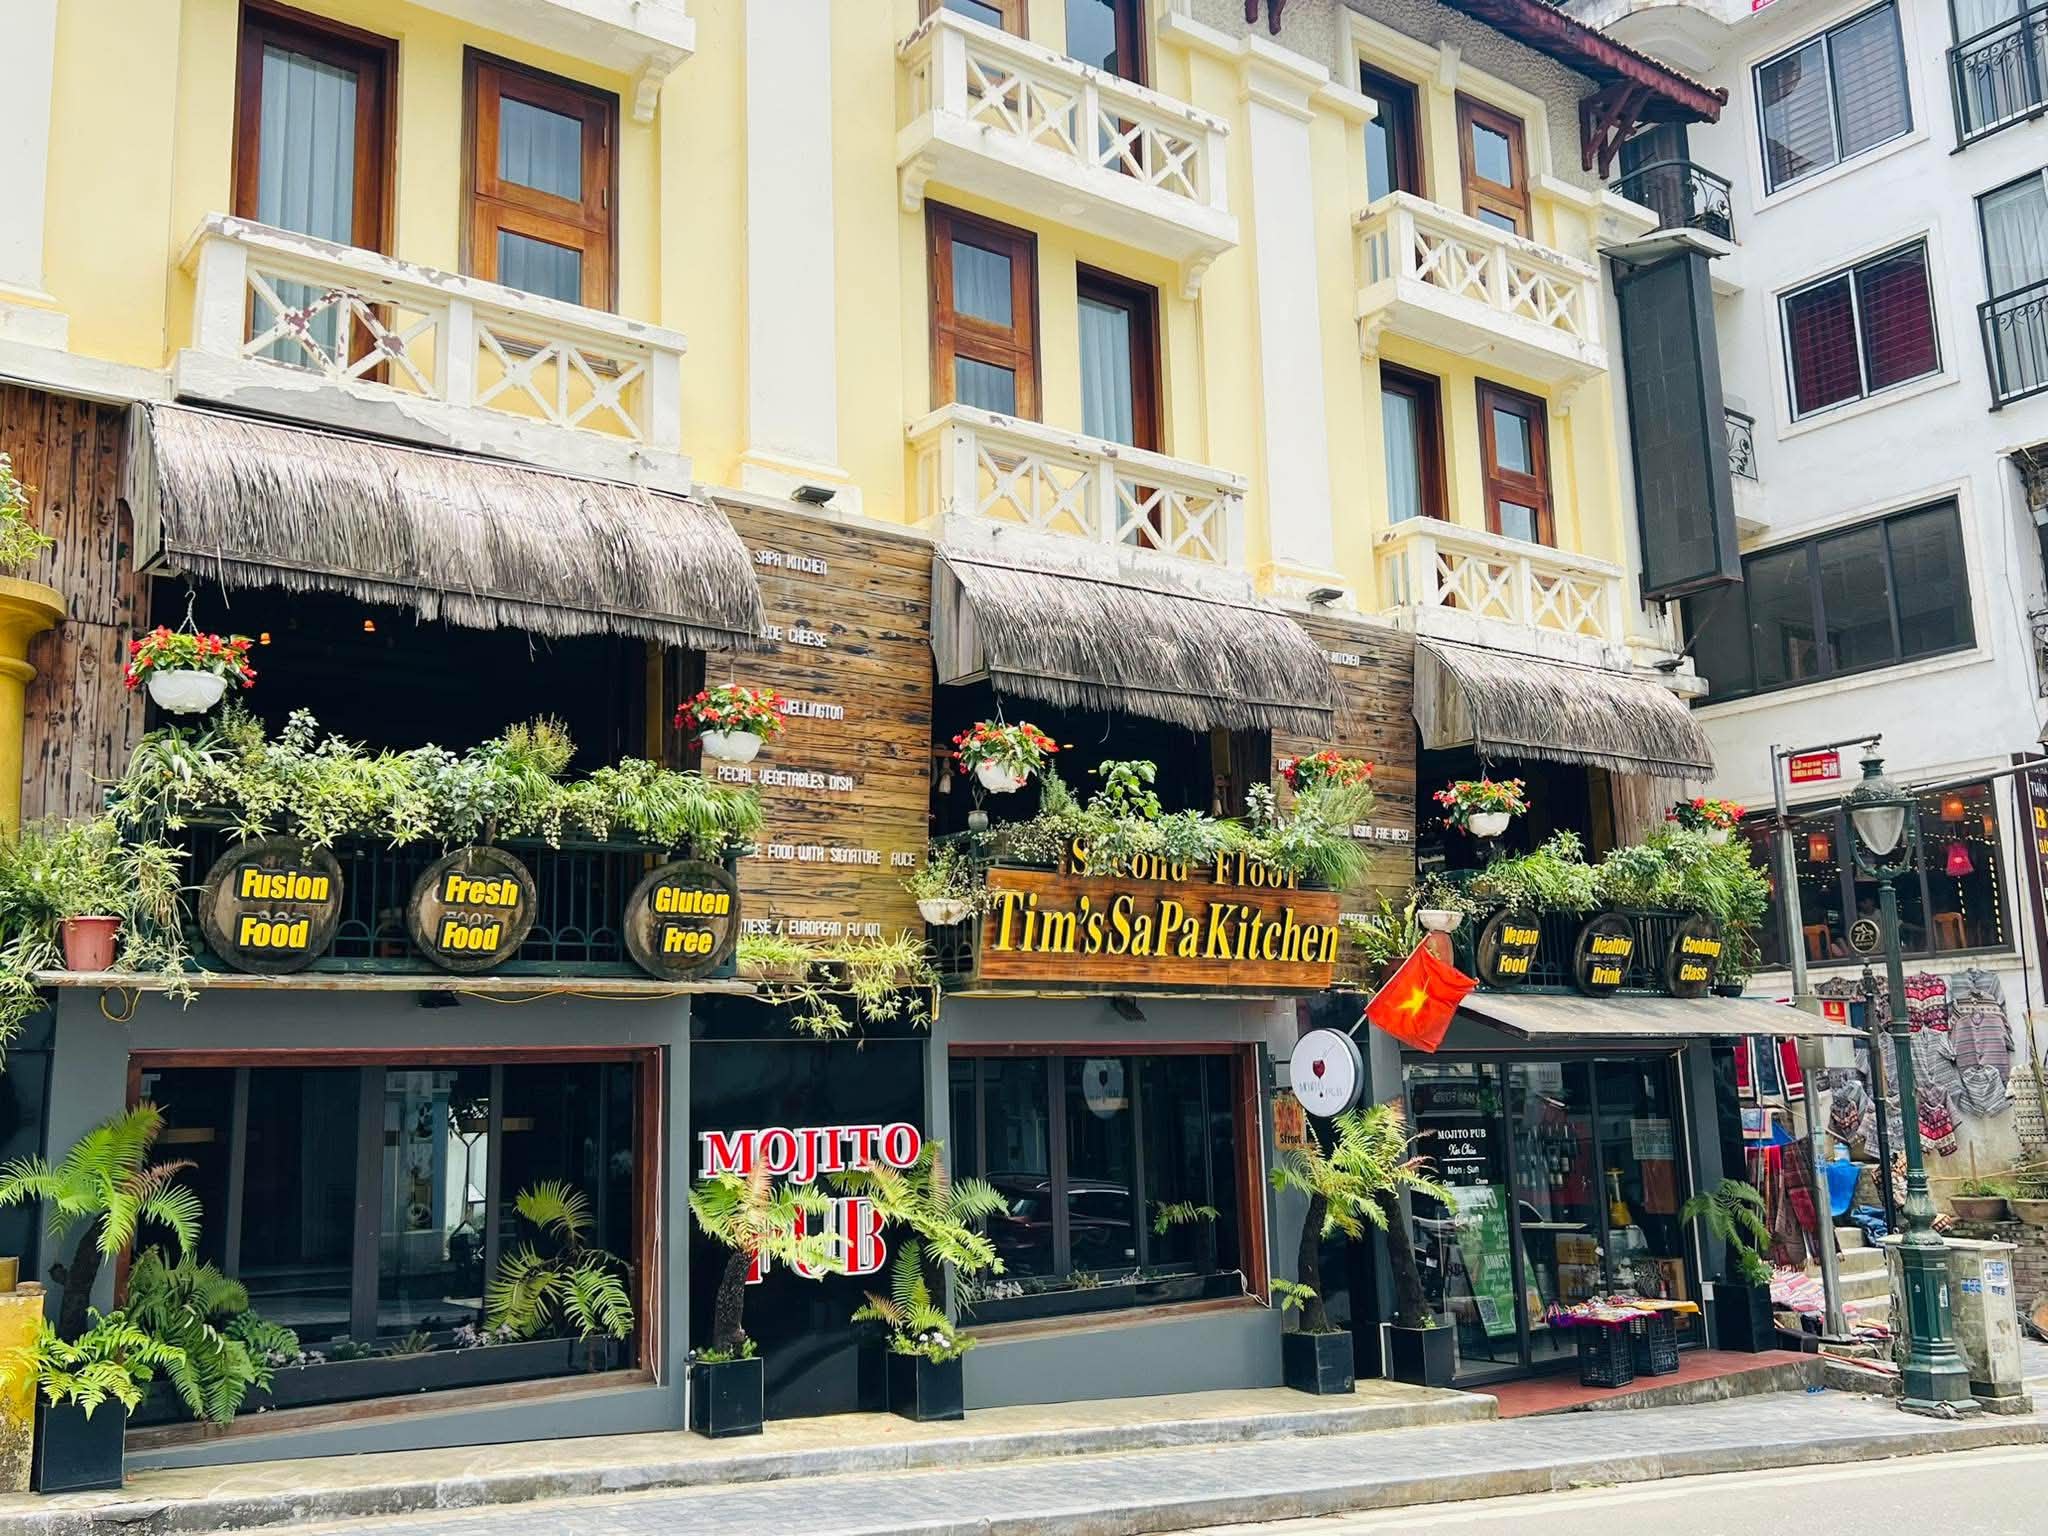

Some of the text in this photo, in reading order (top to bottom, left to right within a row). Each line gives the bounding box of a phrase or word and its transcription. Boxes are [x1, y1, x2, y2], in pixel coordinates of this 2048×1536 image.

[755, 551, 828, 575] SAPA KITCHEN
[788, 628, 828, 648] CHEESE
[759, 769, 825, 789] VEGETABLES
[829, 775, 853, 791] DISH
[768, 844, 795, 860] FOOD
[798, 846, 825, 862] WITH
[830, 847, 881, 865] SIGNATURE
[890, 852, 916, 867] AUCE
[241, 869, 329, 900] Fusion
[445, 875, 519, 906] Fresh
[655, 886, 730, 914] Gluten
[239, 917, 309, 948] Food
[442, 922, 500, 951] Food
[789, 921, 841, 936] EUROPEAN
[1503, 926, 1539, 947] Vegan
[663, 927, 713, 954] Free
[1591, 936, 1632, 957] Healthy
[1681, 936, 1721, 958] Cooking
[1498, 954, 1529, 974] Food
[1591, 966, 1622, 984] Drink
[1680, 964, 1707, 981] Class
[1437, 1128, 1487, 1140] MOJITO PUB
[698, 1122, 921, 1185] MOJITO
[1447, 1165, 1463, 1175] Mon
[1467, 1165, 1480, 1175] Sun
